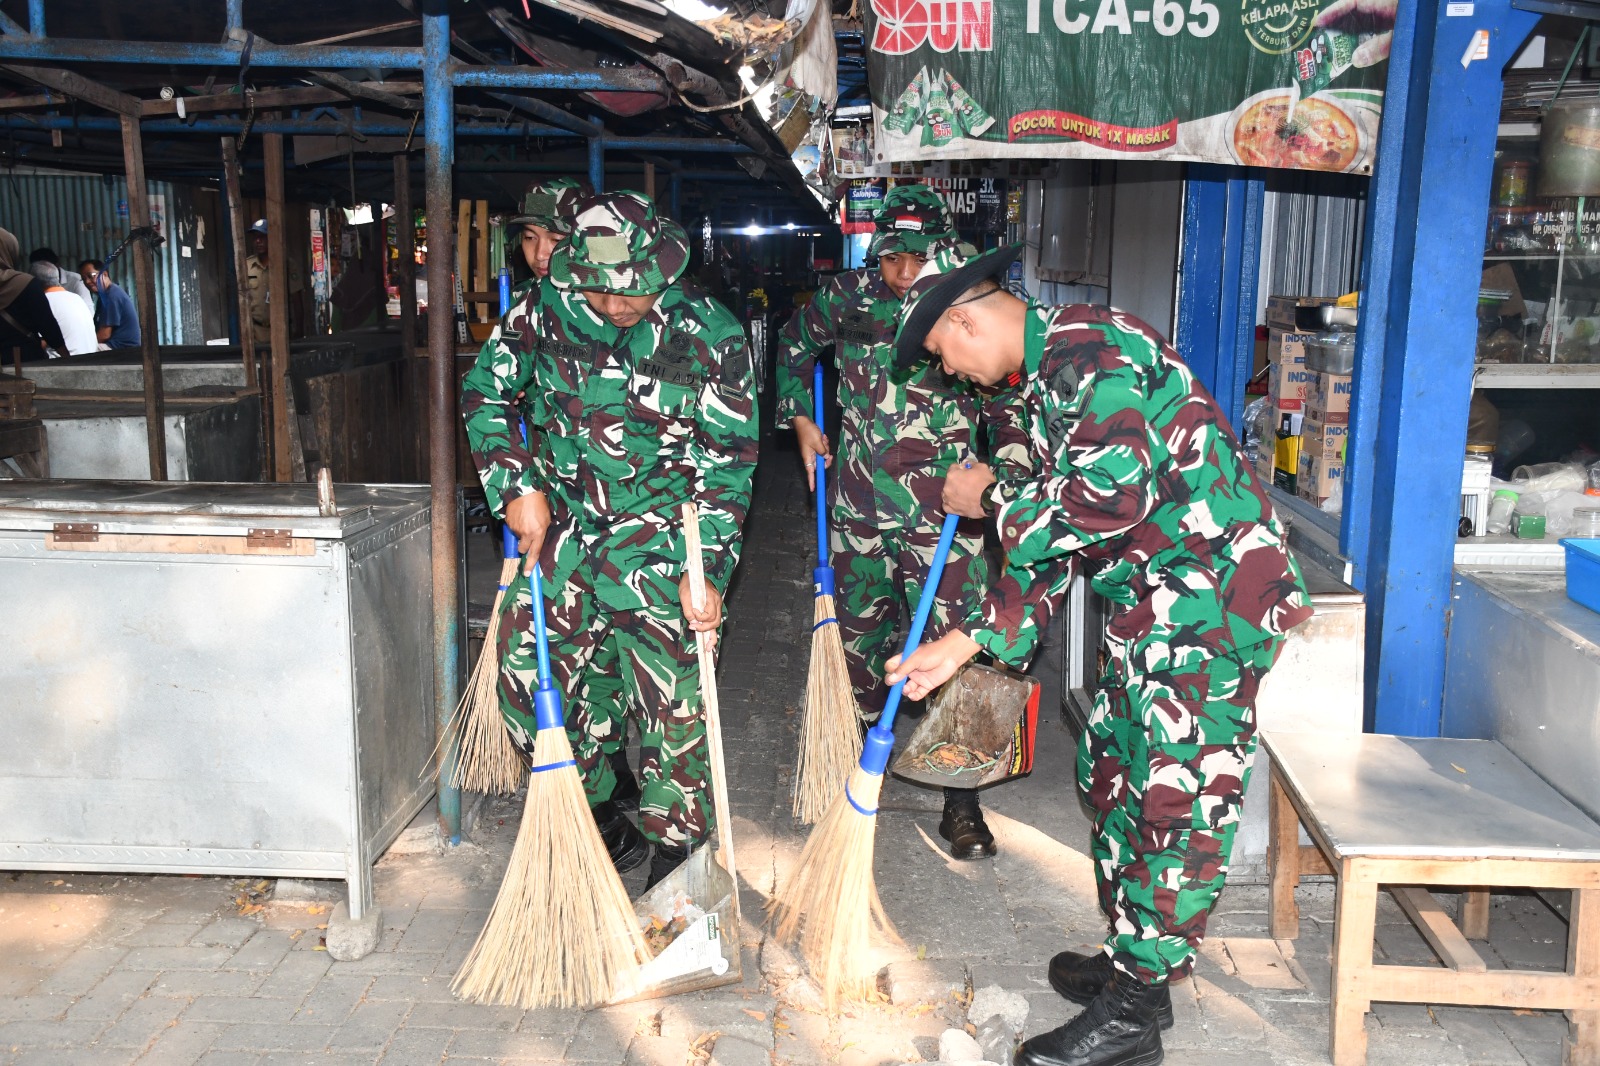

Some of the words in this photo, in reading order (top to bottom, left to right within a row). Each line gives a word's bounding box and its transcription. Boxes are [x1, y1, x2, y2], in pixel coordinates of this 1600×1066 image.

[1241, 3, 1289, 25] KELAPA
[1291, 0, 1319, 12] ASLI
[1257, 27, 1290, 45] TERBUAT
[1291, 17, 1308, 38] DARI
[1013, 115, 1056, 134] COCOK
[1061, 117, 1102, 139] UNTUK
[1107, 129, 1123, 143] 1X
[1126, 128, 1171, 145] MASAK
[852, 190, 880, 199] Salonpas
[979, 177, 994, 193] 3X
[642, 363, 666, 377] TNI
[672, 372, 695, 385] AD
